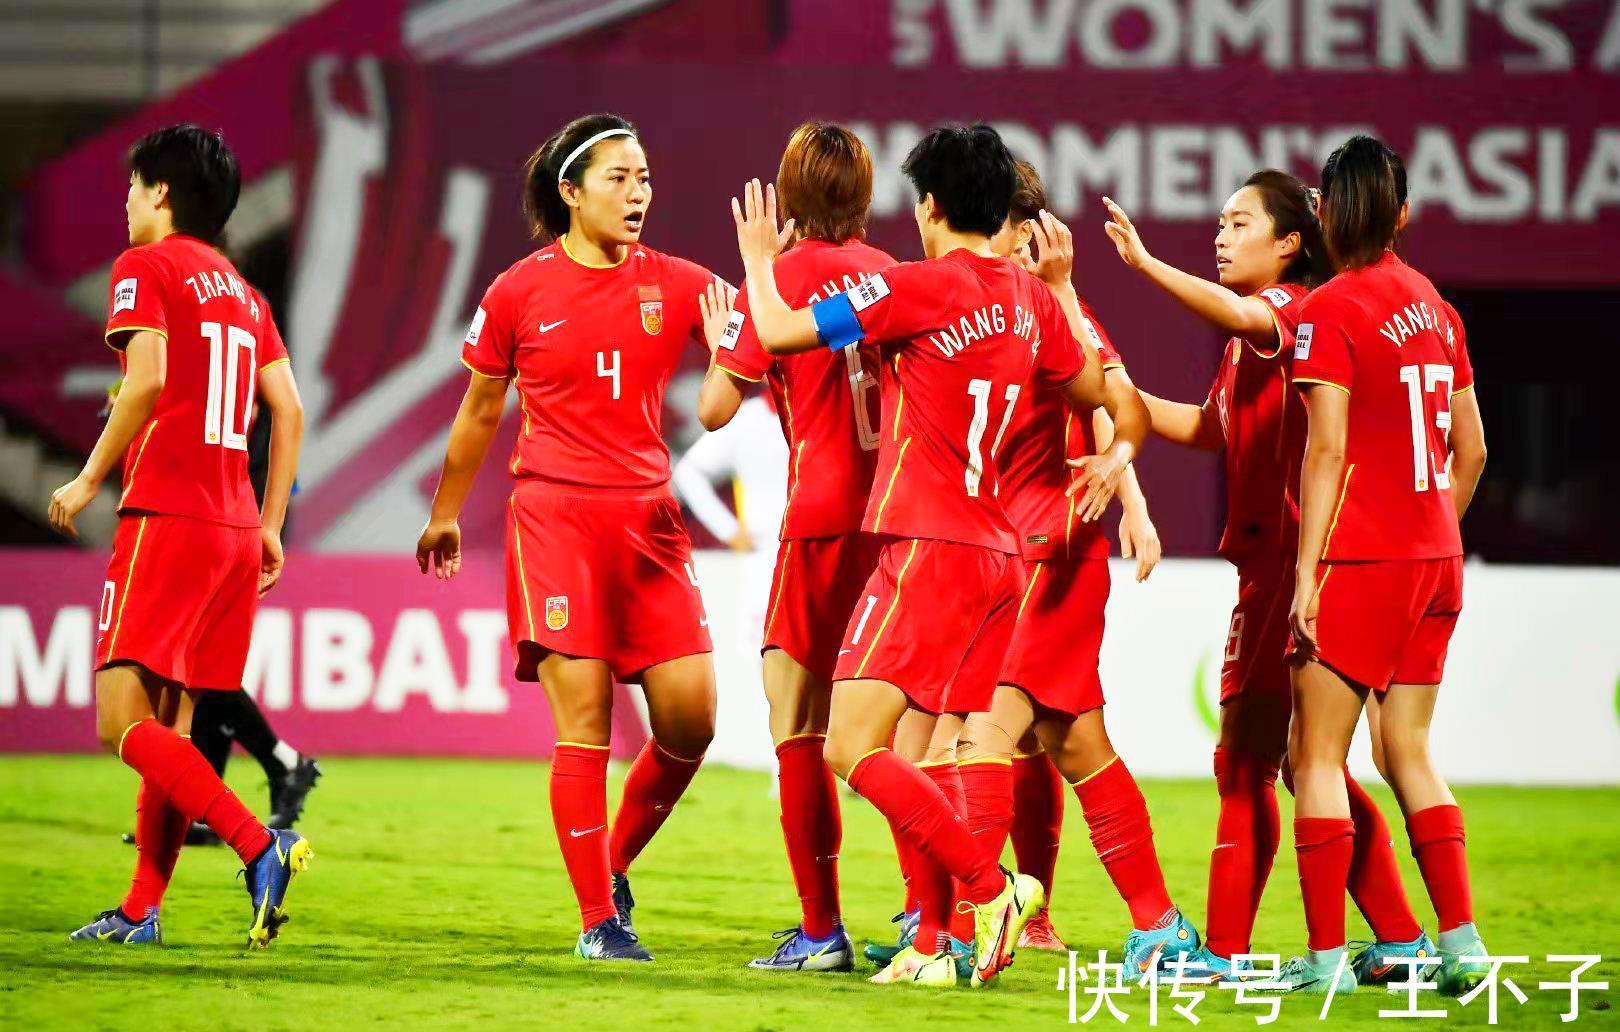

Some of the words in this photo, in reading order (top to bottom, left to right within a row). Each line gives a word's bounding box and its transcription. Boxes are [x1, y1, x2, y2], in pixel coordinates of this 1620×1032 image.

[185, 268, 246, 305] ZHANG
[929, 304, 1006, 357] WANG
[1378, 301, 1433, 348] YANG
[200, 321, 257, 451] 10
[596, 350, 620, 400] 4
[966, 378, 1021, 496] 11
[1400, 364, 1454, 492] 13
[851, 595, 878, 645] 1
